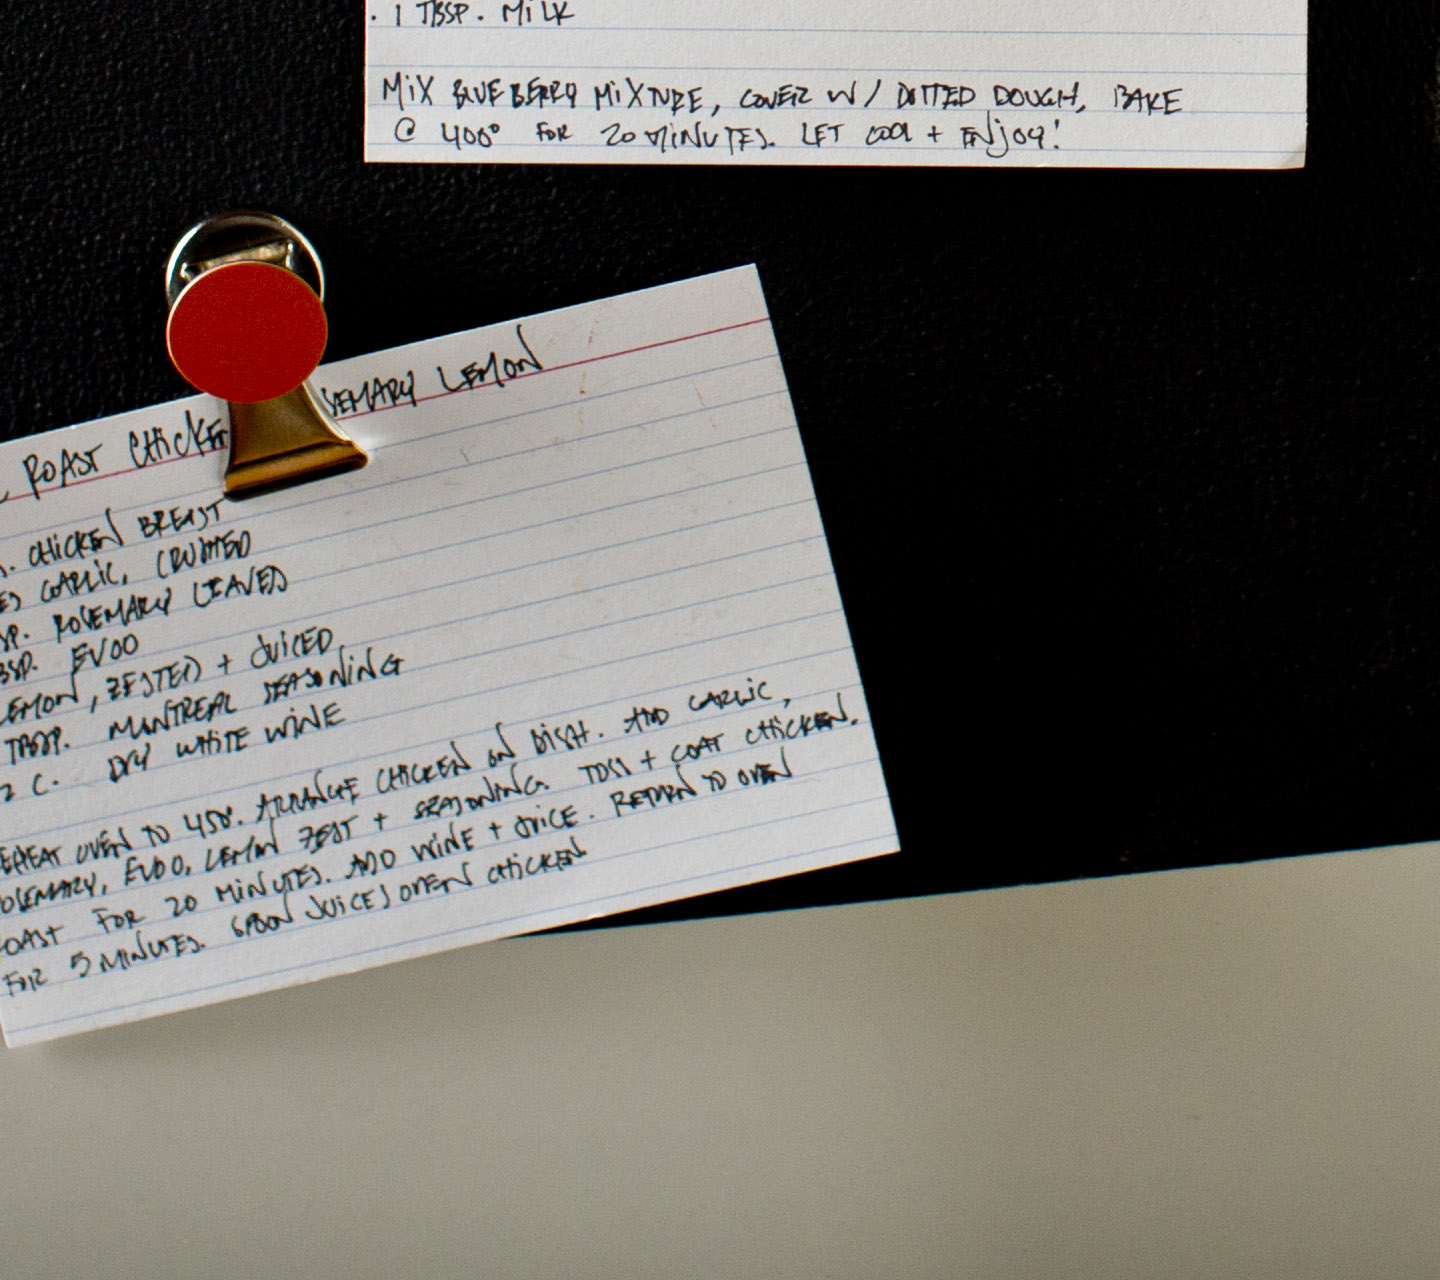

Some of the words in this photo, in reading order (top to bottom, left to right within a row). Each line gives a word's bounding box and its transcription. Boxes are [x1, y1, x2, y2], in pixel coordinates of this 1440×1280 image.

[382, 71, 435, 111] MIX
[739, 82, 814, 110] COVER
[1114, 85, 1183, 115] BAKE
[535, 122, 573, 143] FOR
[600, 123, 637, 147] 20
[801, 122, 845, 146] LET
[22, 443, 103, 501] ROAST
[437, 324, 543, 391] LEMON
[29, 507, 124, 567] CHICKEN
[137, 497, 225, 538] BREAST
[52, 586, 173, 644] ROSEMARY
[193, 564, 289, 608] LEAVES
[71, 633, 139, 672] EVOO
[176, 726, 250, 758] WHITE
[264, 702, 346, 743] WINE
[76, 827, 133, 865] OVEN
[141, 824, 171, 848] TO
[376, 740, 472, 794] CHICKEN
[298, 814, 360, 855] ZEST
[670, 732, 725, 763] COAT
[91, 907, 146, 934] FOR
[164, 894, 198, 918] 20
[411, 821, 475, 862] WINE
[737, 746, 793, 787] OVEN
[2, 967, 49, 998] FOR
[70, 950, 91, 978] 5
[487, 835, 587, 884] CHICKEN
